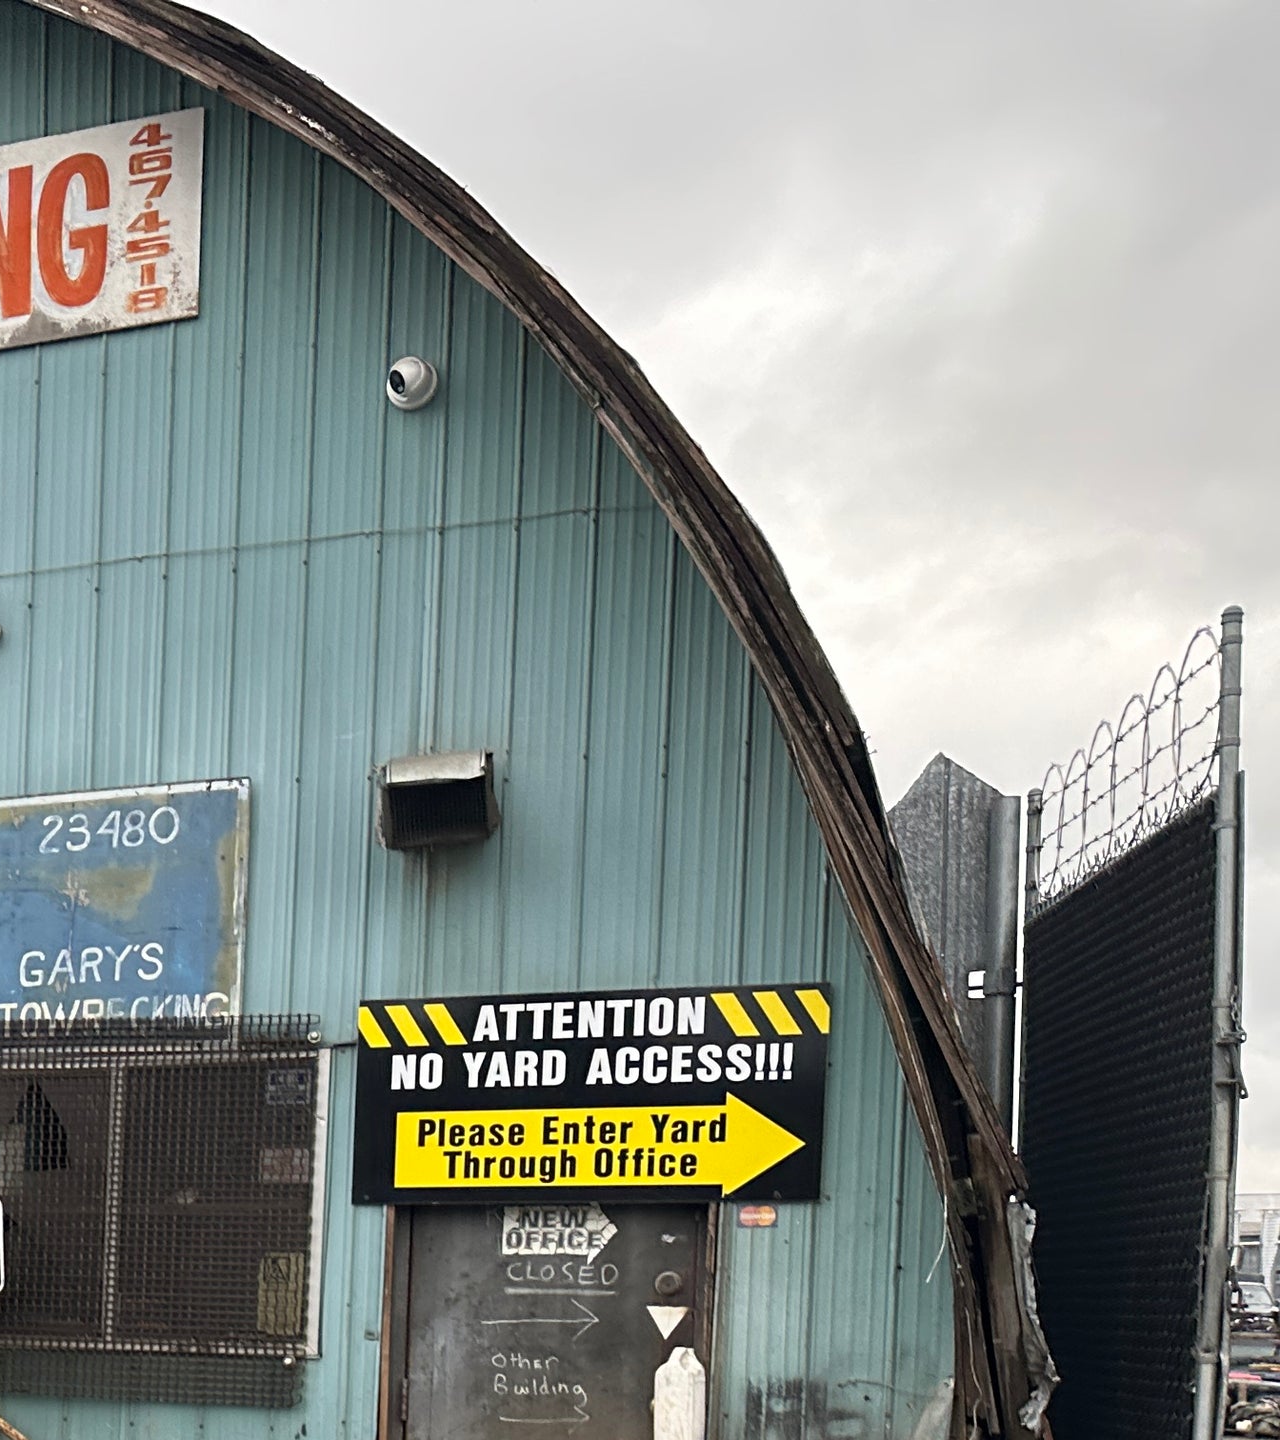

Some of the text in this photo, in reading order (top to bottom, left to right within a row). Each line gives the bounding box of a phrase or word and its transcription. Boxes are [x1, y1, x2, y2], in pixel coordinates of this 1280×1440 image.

[39, 806, 180, 854] 23480
[19, 942, 163, 988] GARY'S
[473, 996, 706, 1042] ATTENTION
[390, 1042, 794, 1091] NO YARD ACCESS!!!
[418, 1112, 727, 1147] Please Enter Yard
[443, 1147, 698, 1183] Through Office
[519, 1208, 589, 1229] NEW
[505, 1229, 605, 1251] OFFICE
[506, 1262, 619, 1286] CLOSED
[491, 1352, 559, 1371] Other
[493, 1373, 588, 1408] Building
